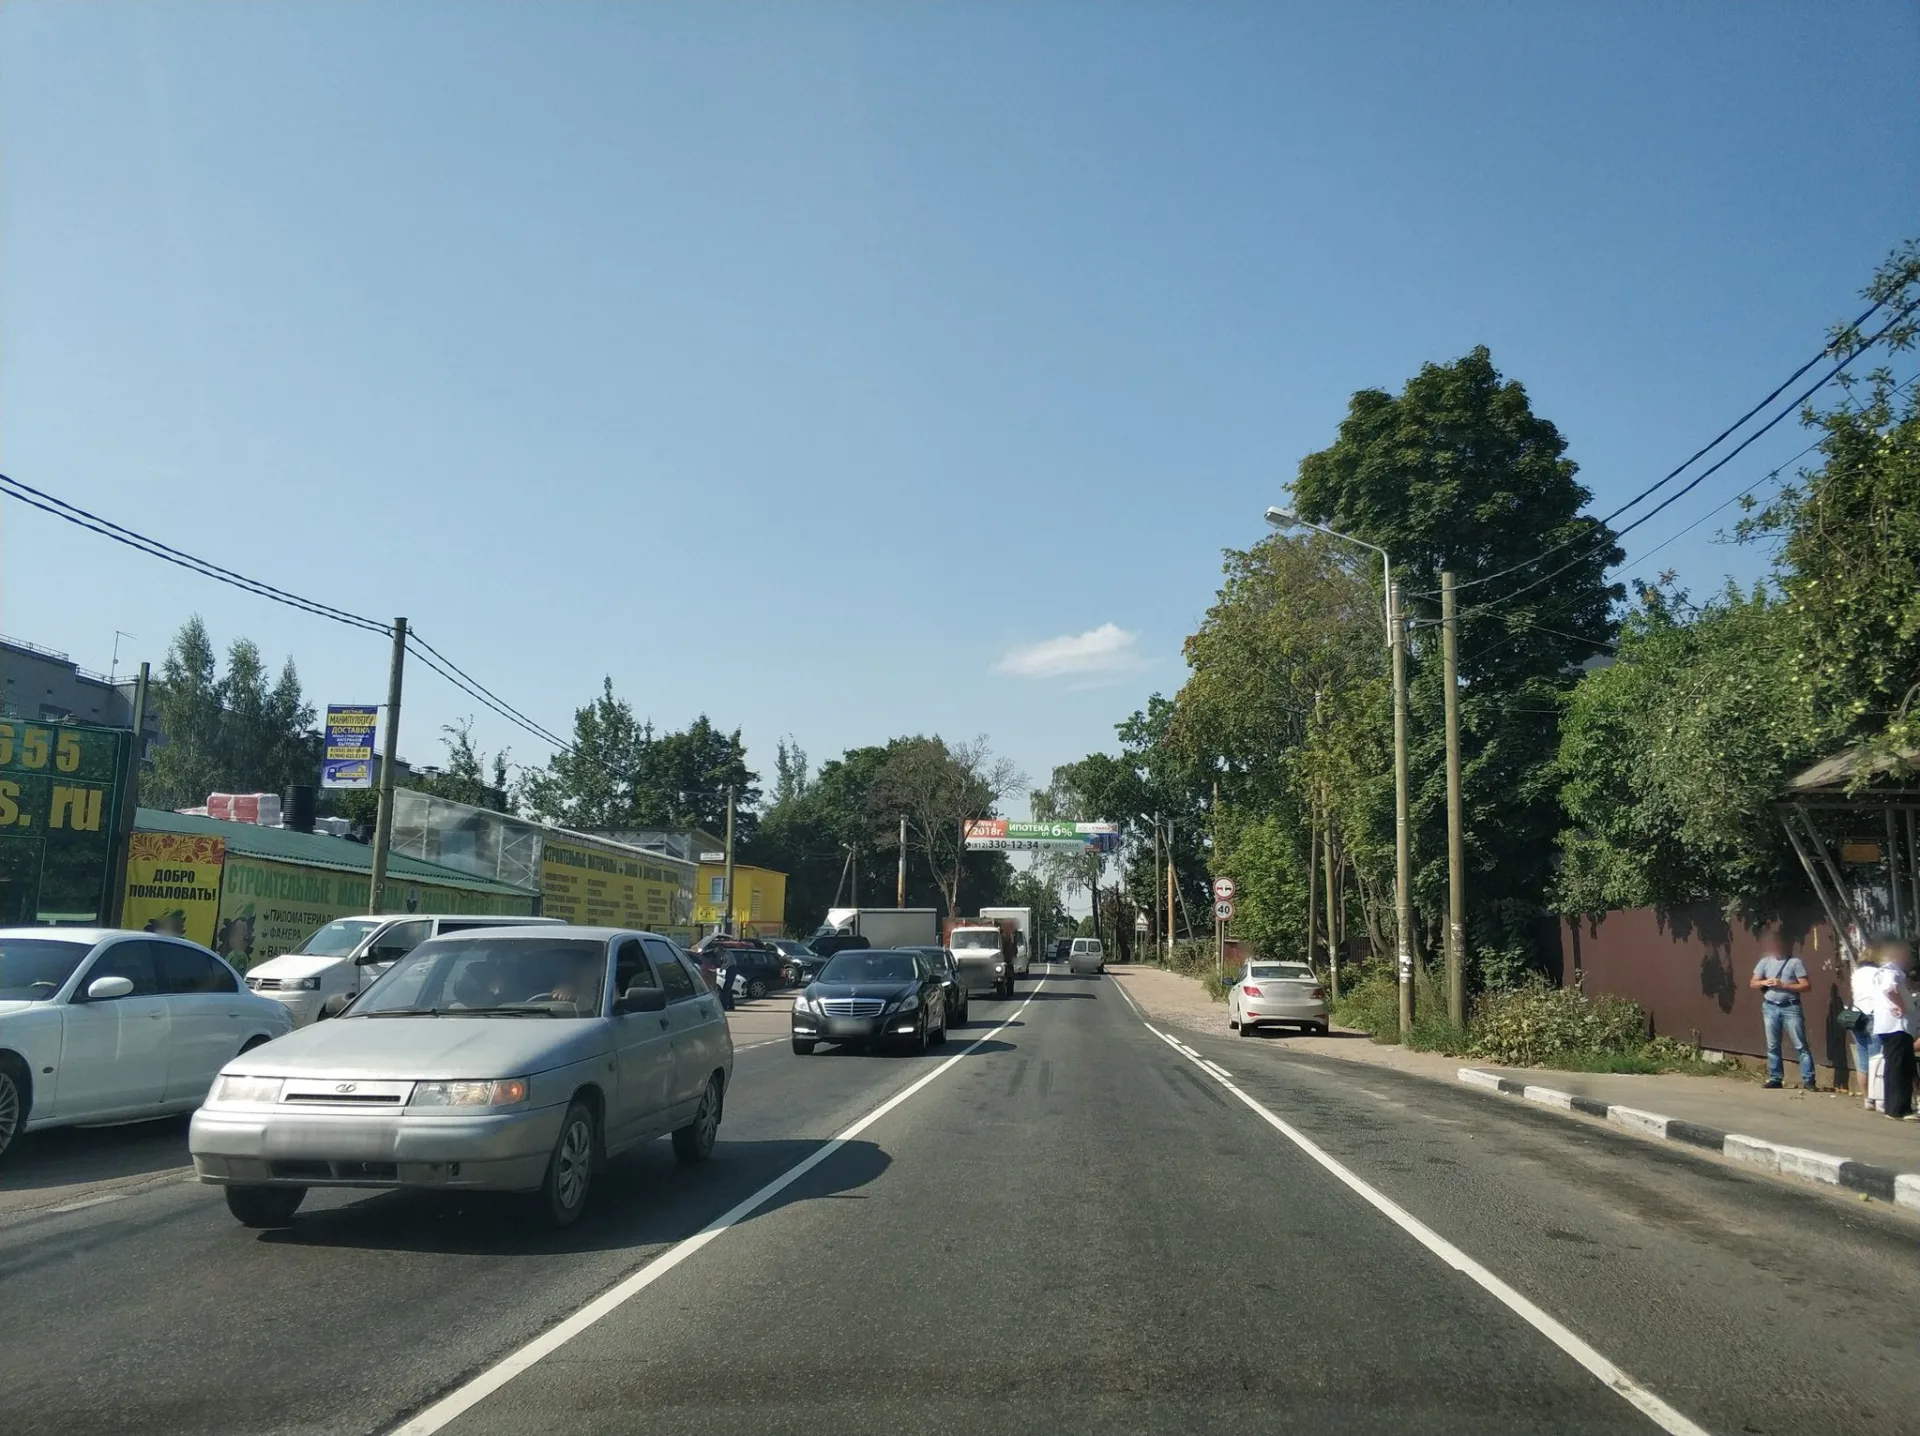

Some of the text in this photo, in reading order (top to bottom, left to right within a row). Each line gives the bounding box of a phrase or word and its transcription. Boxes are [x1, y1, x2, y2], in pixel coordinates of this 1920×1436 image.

[330, 715, 376, 725] МАНИПУЛЯТОР
[972, 827, 1004, 836] 2018г.
[1009, 824, 1050, 832] ИПОТЕКА
[152, 869, 196, 884] ДОБРО
[227, 864, 330, 904] СТРОИТЕЛЬНЫЕ
[129, 884, 216, 901] ПОЖАЛОВАТЬ!
[1218, 905, 1230, 914] 40
[270, 927, 302, 941] ФАНЕРА
